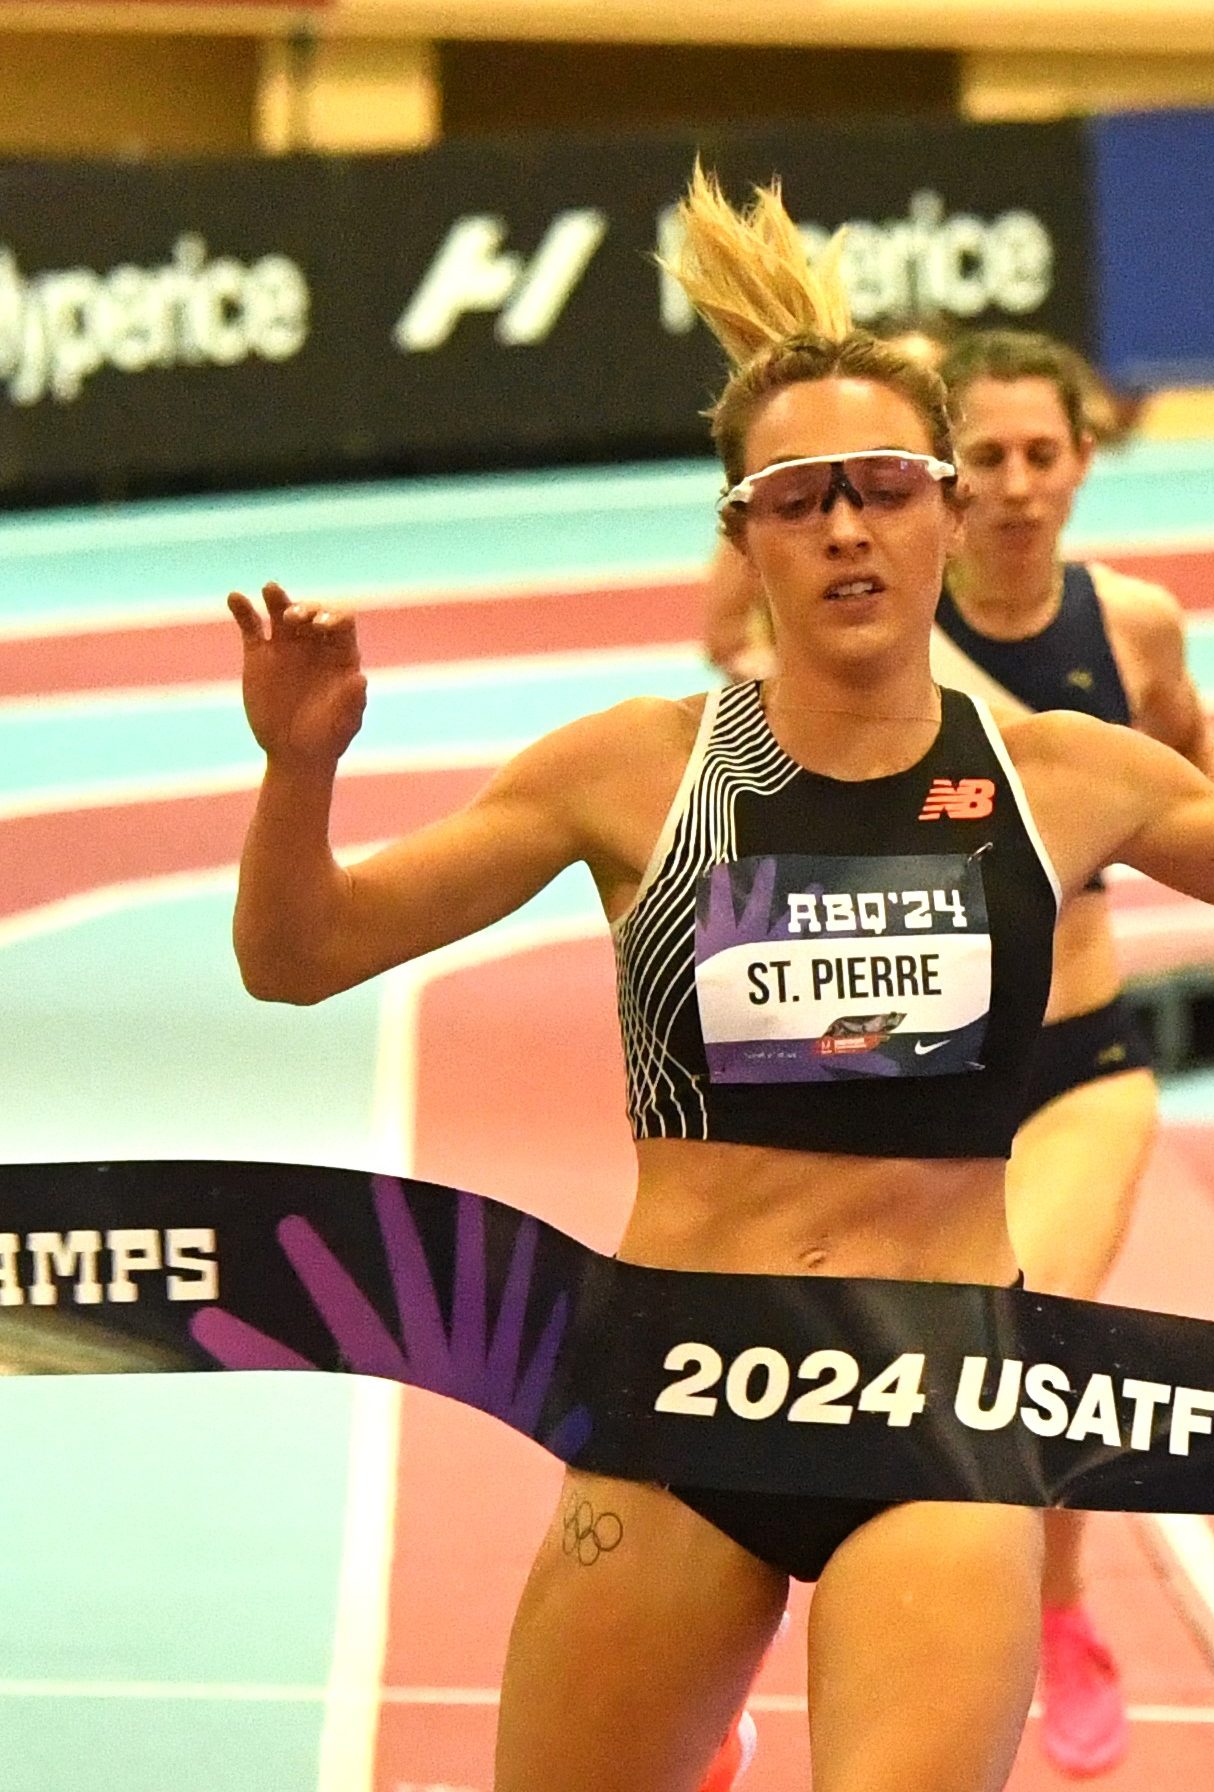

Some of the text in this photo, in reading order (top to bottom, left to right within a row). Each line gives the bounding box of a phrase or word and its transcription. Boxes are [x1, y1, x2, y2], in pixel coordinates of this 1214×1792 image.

[786, 888, 968, 935] ABQ'24
[746, 953, 943, 1006] ST. PIERRE
[654, 1341, 926, 1428] 2024
